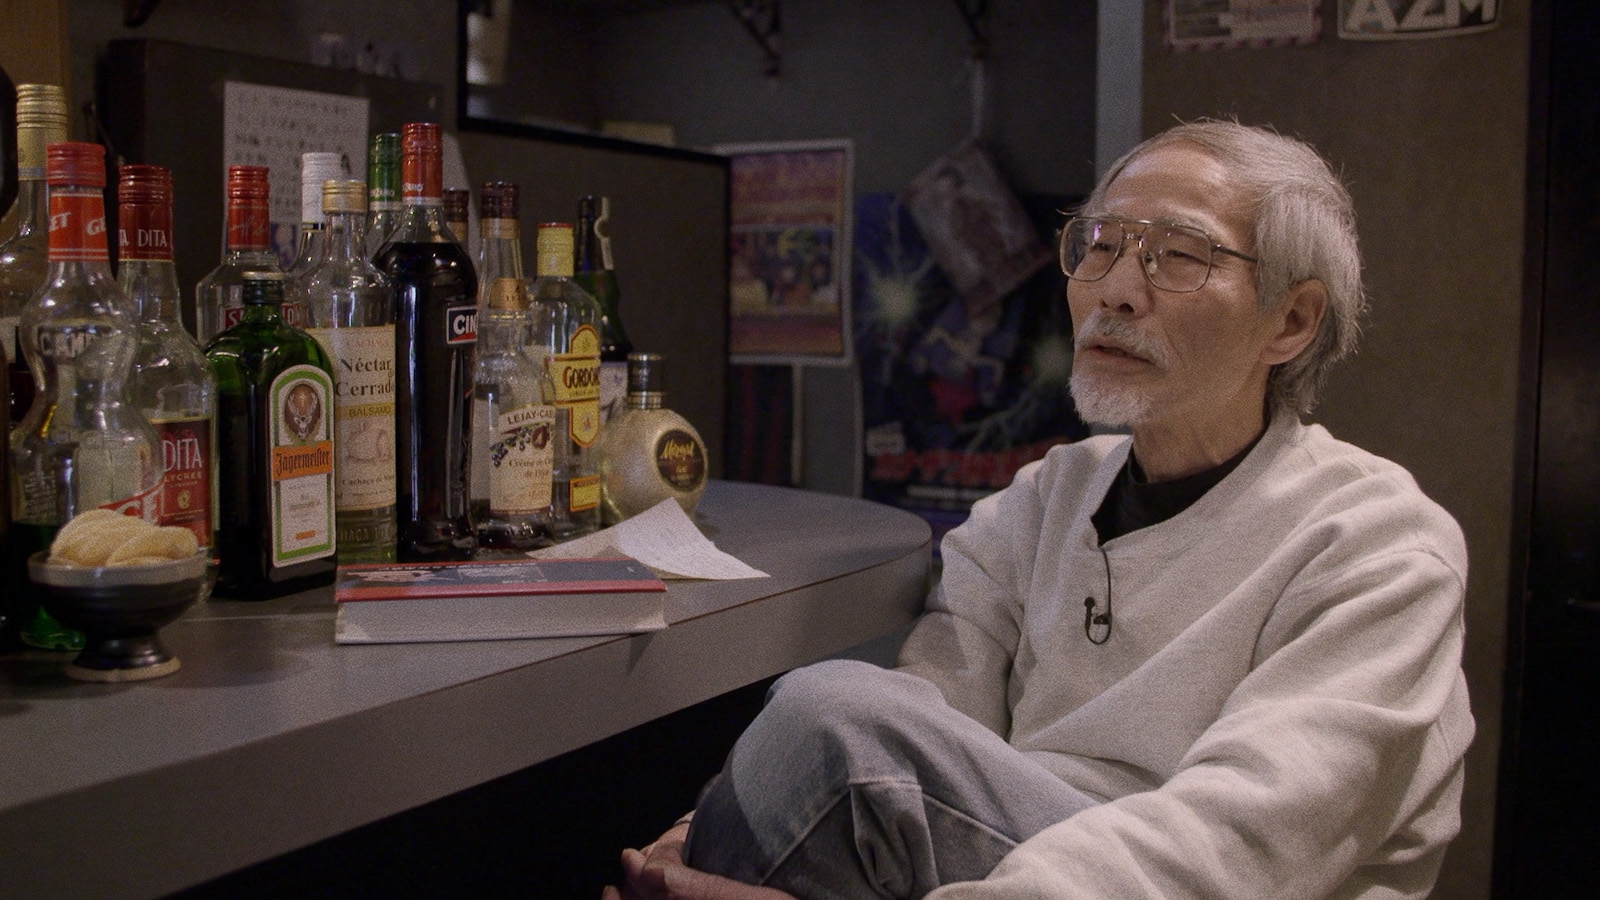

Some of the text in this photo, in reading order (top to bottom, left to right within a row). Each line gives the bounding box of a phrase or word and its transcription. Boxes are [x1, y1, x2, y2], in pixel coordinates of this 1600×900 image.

[137, 229, 167, 247] DITA
[340, 357, 391, 373] Néctar
[336, 379, 394, 397] Cerrad
[162, 437, 203, 472] DITA
